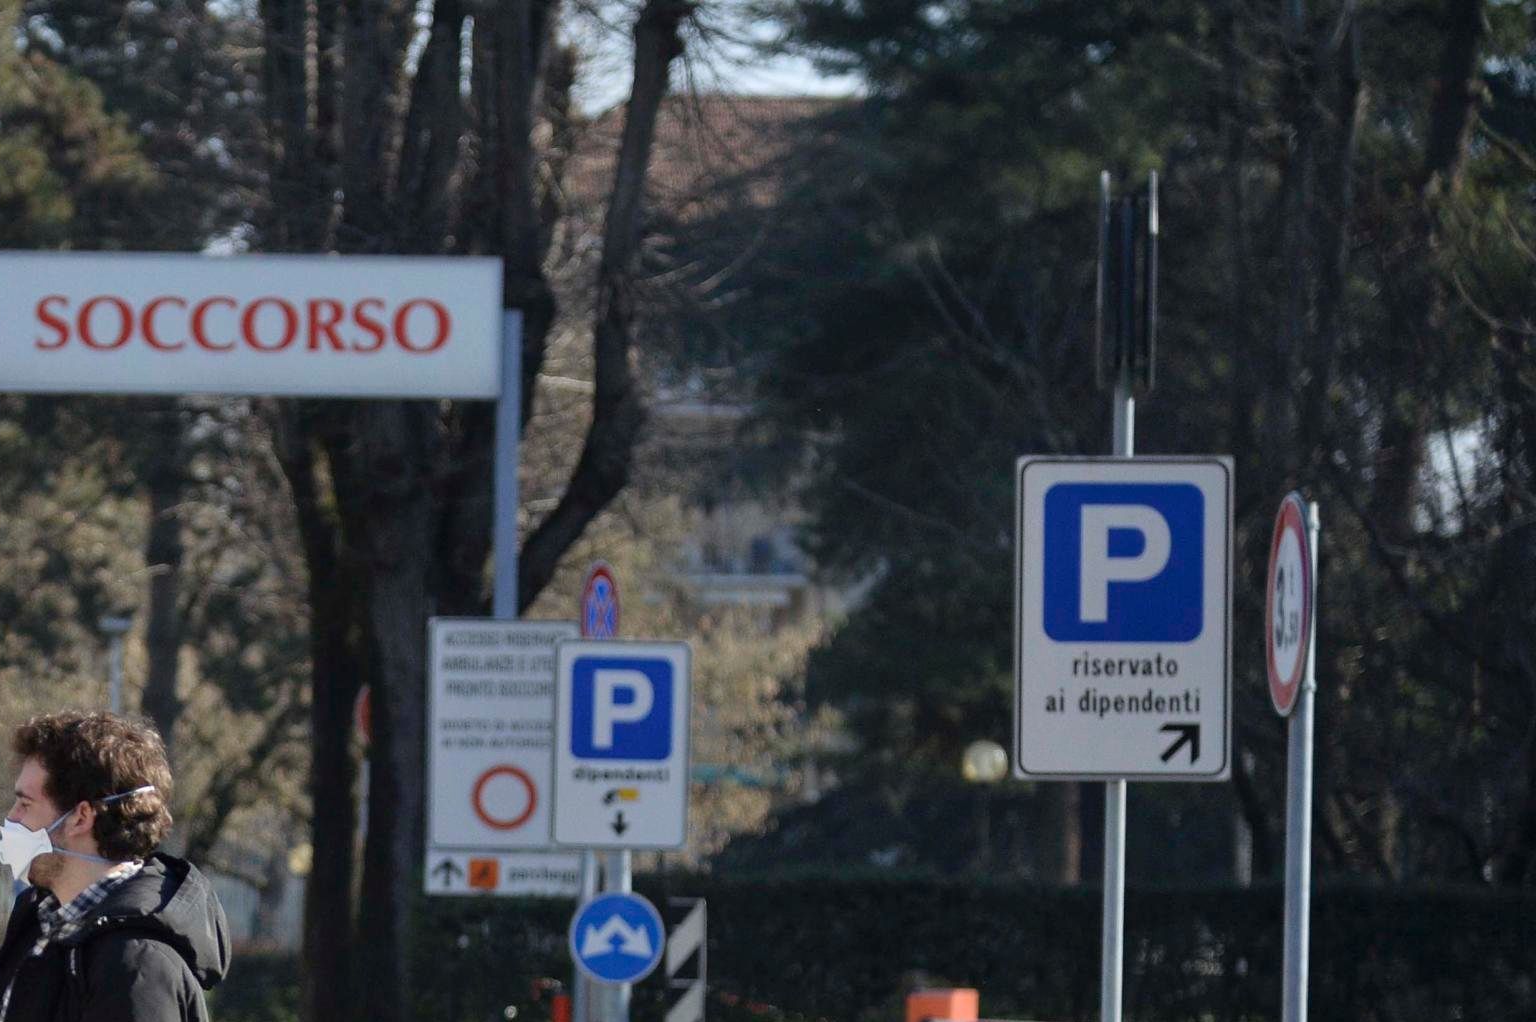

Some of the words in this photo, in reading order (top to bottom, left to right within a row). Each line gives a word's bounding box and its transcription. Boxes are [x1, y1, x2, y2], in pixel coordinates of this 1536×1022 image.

[33, 293, 453, 355] SOCCORSO
[1079, 503, 1172, 623] P
[1071, 653, 1179, 679] riservato
[498, 680, 553, 697] SOCCOR
[1045, 689, 1065, 713] ai
[1078, 688, 1201, 719] dipendenti
[592, 668, 655, 749] P
[572, 767, 671, 785] dipendenti
